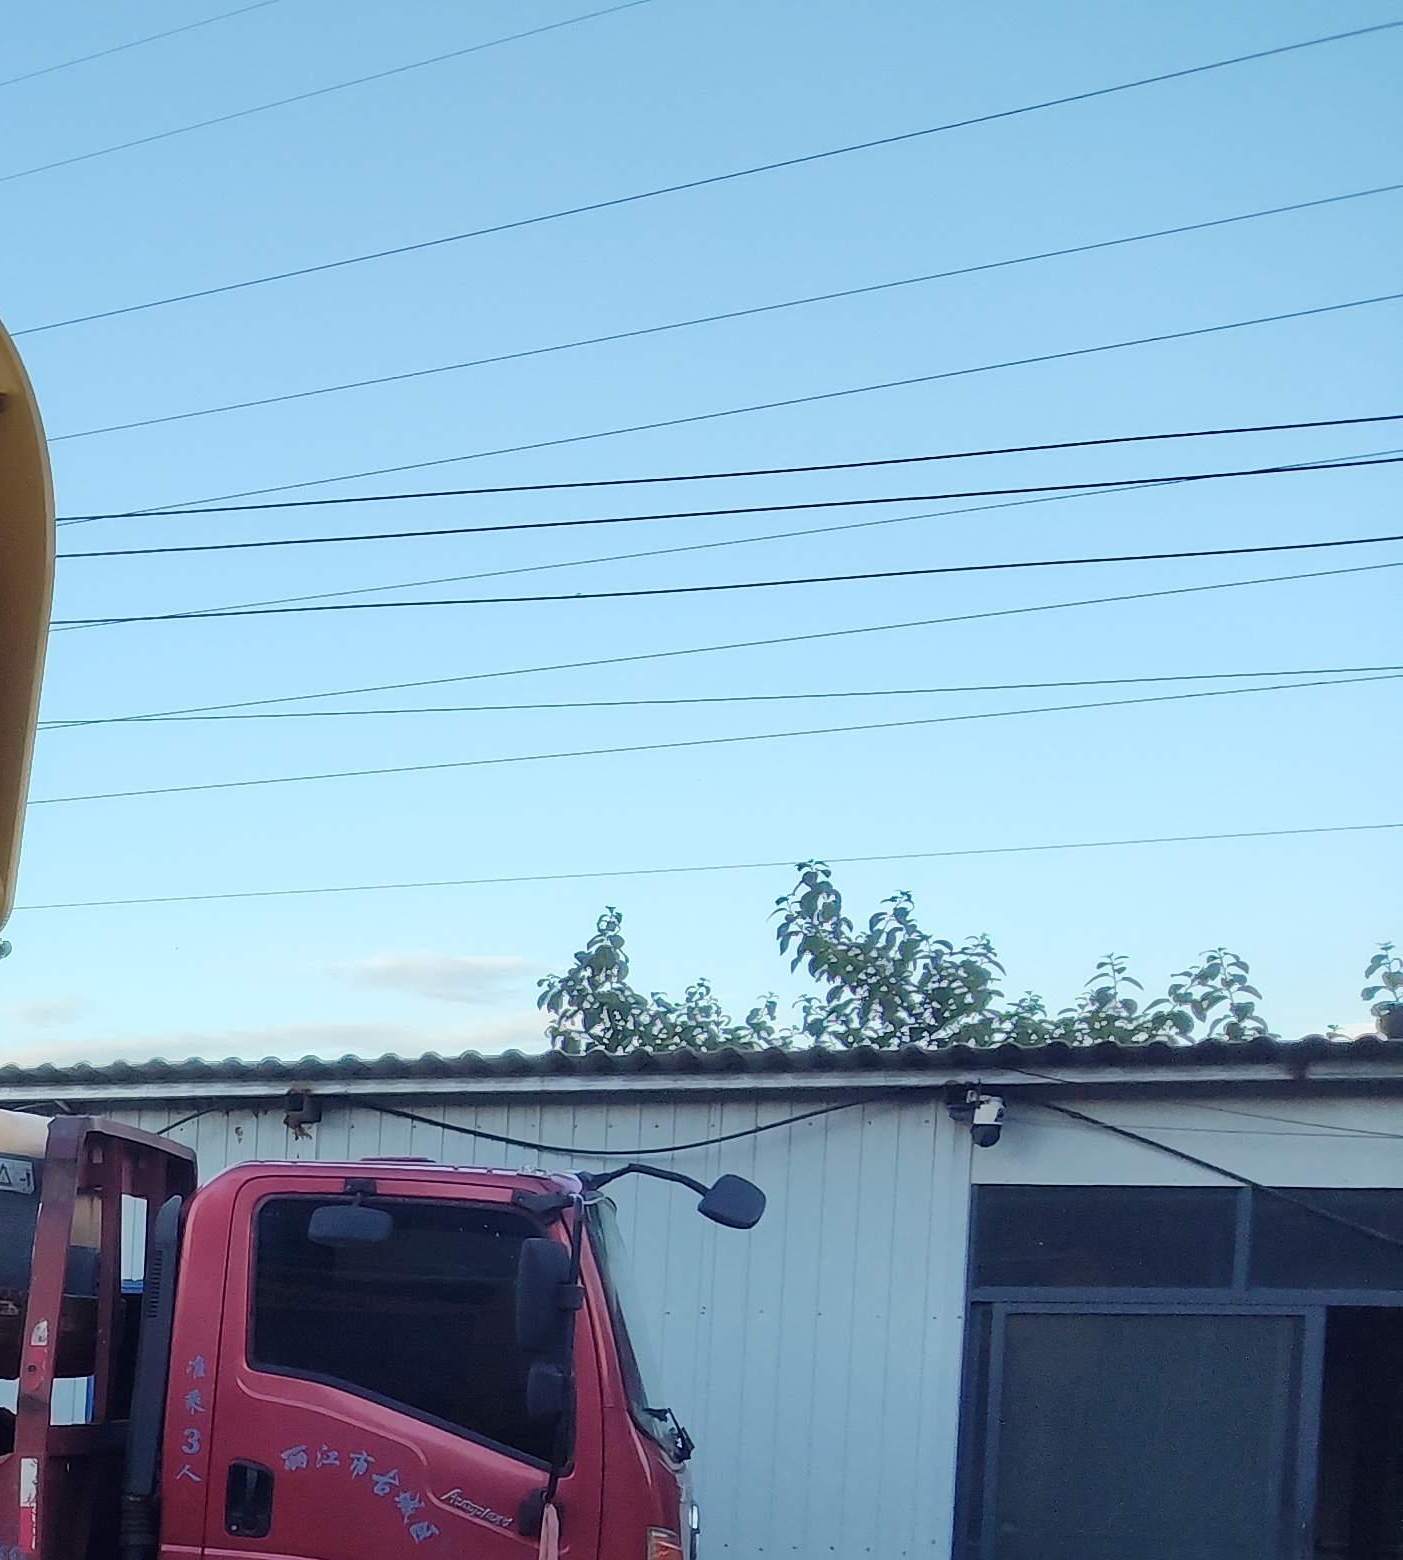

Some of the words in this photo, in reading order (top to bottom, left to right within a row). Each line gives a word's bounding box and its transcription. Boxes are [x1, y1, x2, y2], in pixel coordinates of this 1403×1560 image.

[281, 1444, 440, 1544] 丽江市古城区
